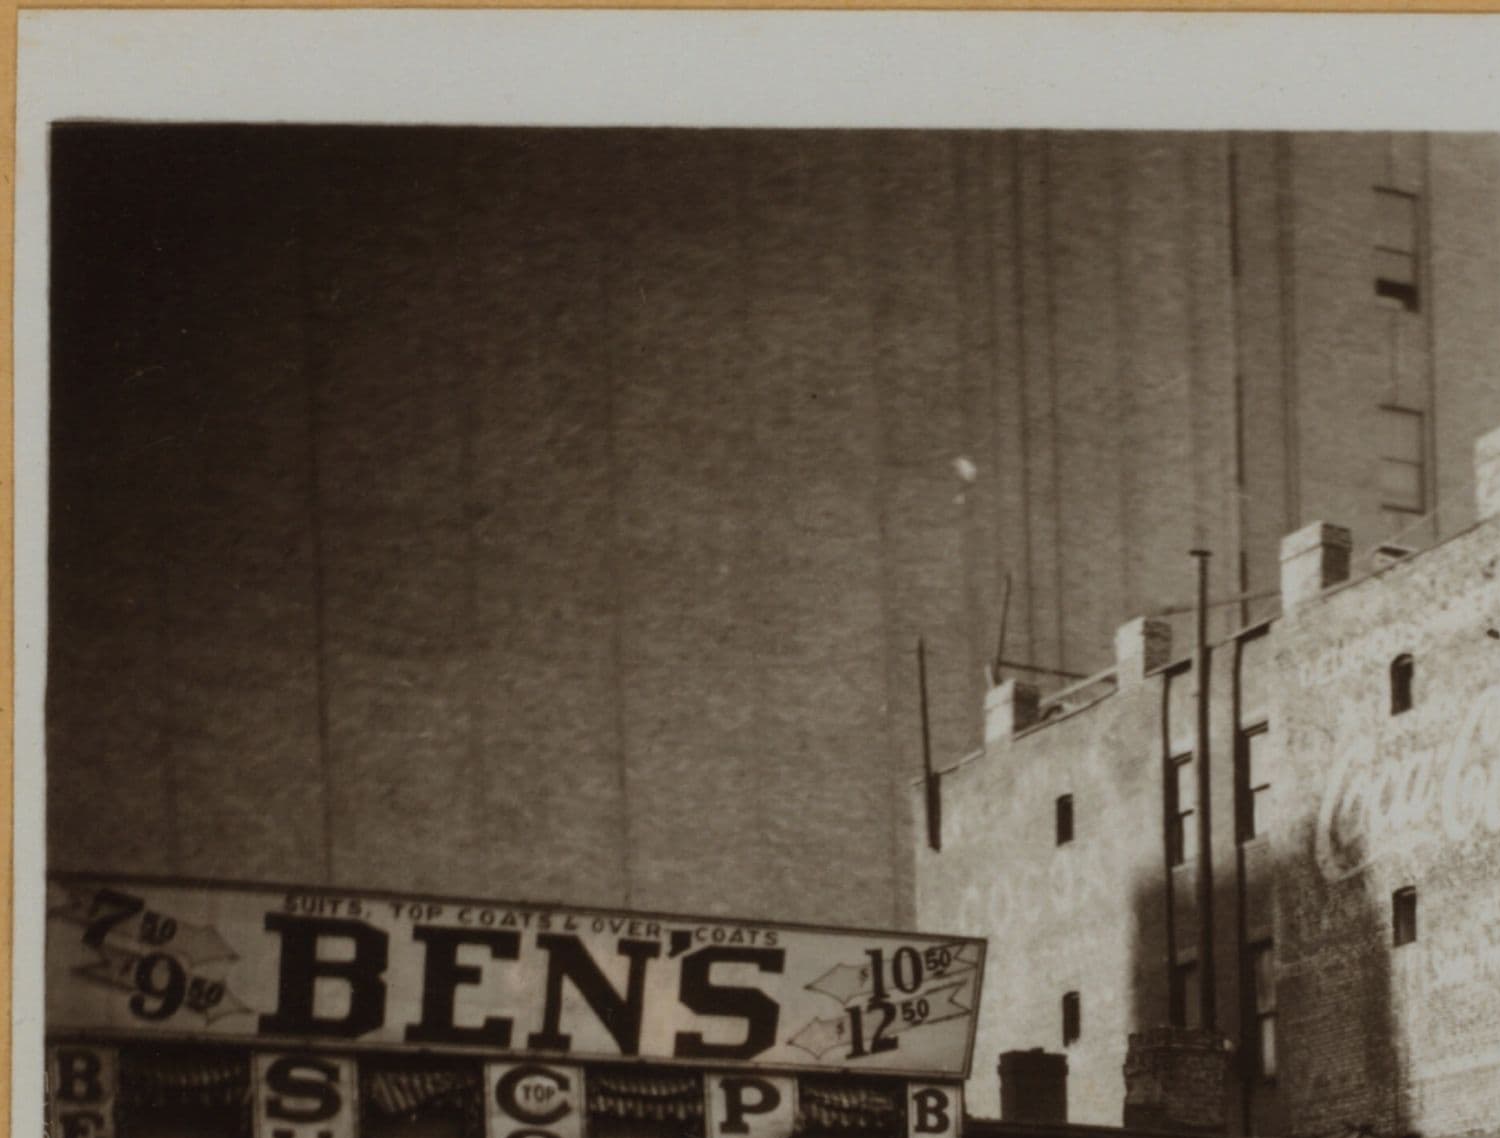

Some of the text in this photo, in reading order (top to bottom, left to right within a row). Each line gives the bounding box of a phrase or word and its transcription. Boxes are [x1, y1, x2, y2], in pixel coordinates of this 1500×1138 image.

[389, 902, 443, 921] TOP
[457, 908, 552, 930] COATS
[258, 910, 786, 1062] BEN'S
[521, 1083, 556, 1104] TOP
